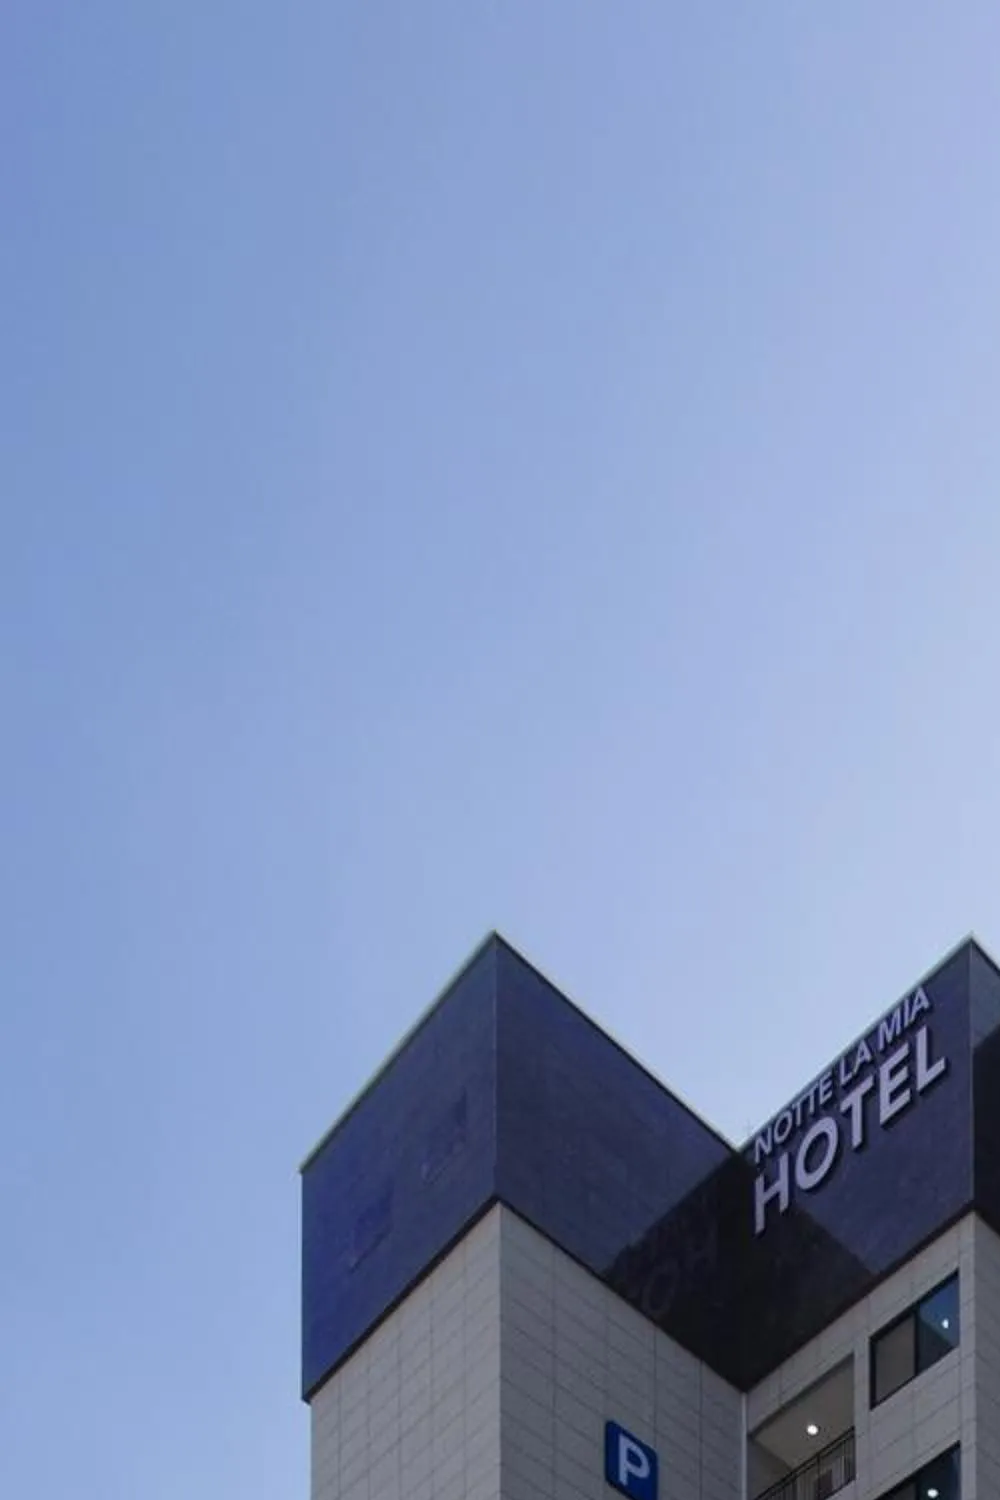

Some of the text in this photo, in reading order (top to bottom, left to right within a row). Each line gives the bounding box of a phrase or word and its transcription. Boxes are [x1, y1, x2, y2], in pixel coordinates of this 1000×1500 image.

[754, 986, 930, 1163] NOTTE LA MIA
[754, 1024, 946, 1236] HOTEL
[618, 1432, 650, 1486] P
